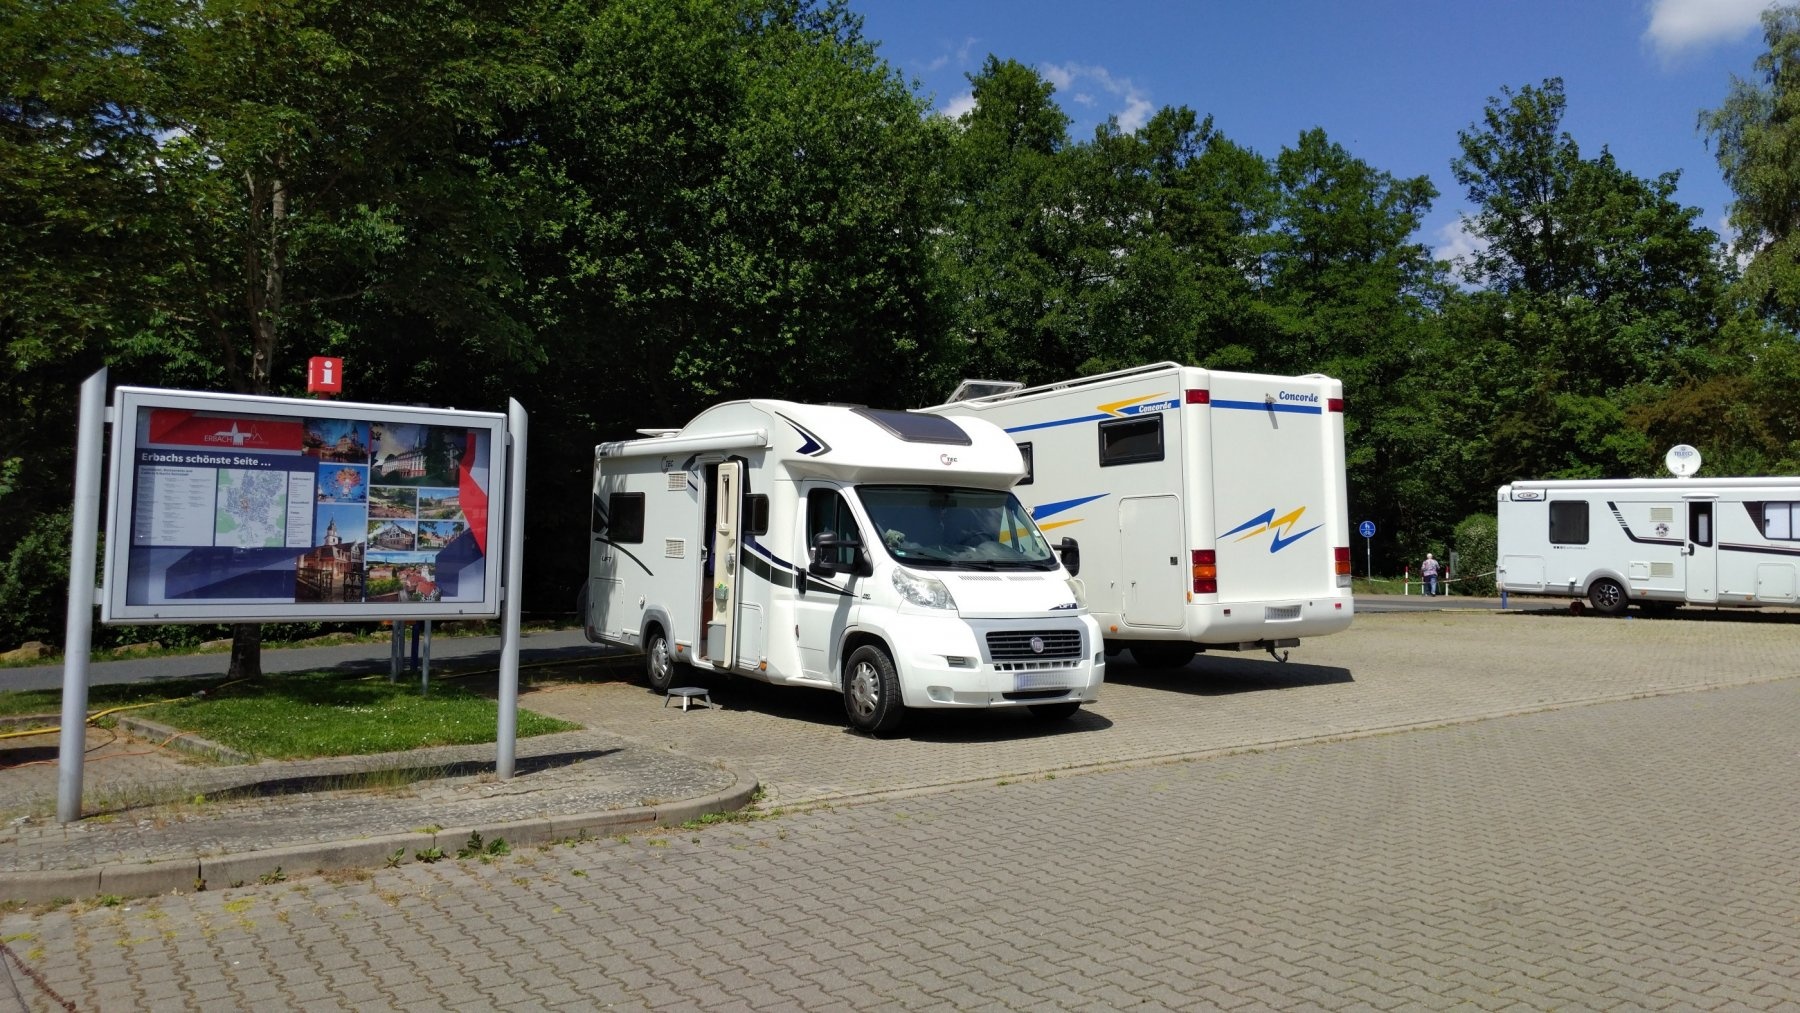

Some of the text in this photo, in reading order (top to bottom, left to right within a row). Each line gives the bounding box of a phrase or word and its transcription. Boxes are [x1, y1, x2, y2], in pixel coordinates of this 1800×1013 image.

[1279, 390, 1318, 403] Concorde
[1138, 402, 1171, 413] Concorde
[204, 434, 232, 443] ERBACH
[141, 453, 183, 462] Erbachs
[185, 455, 231, 465] schönste
[233, 457, 259, 466] Seite
